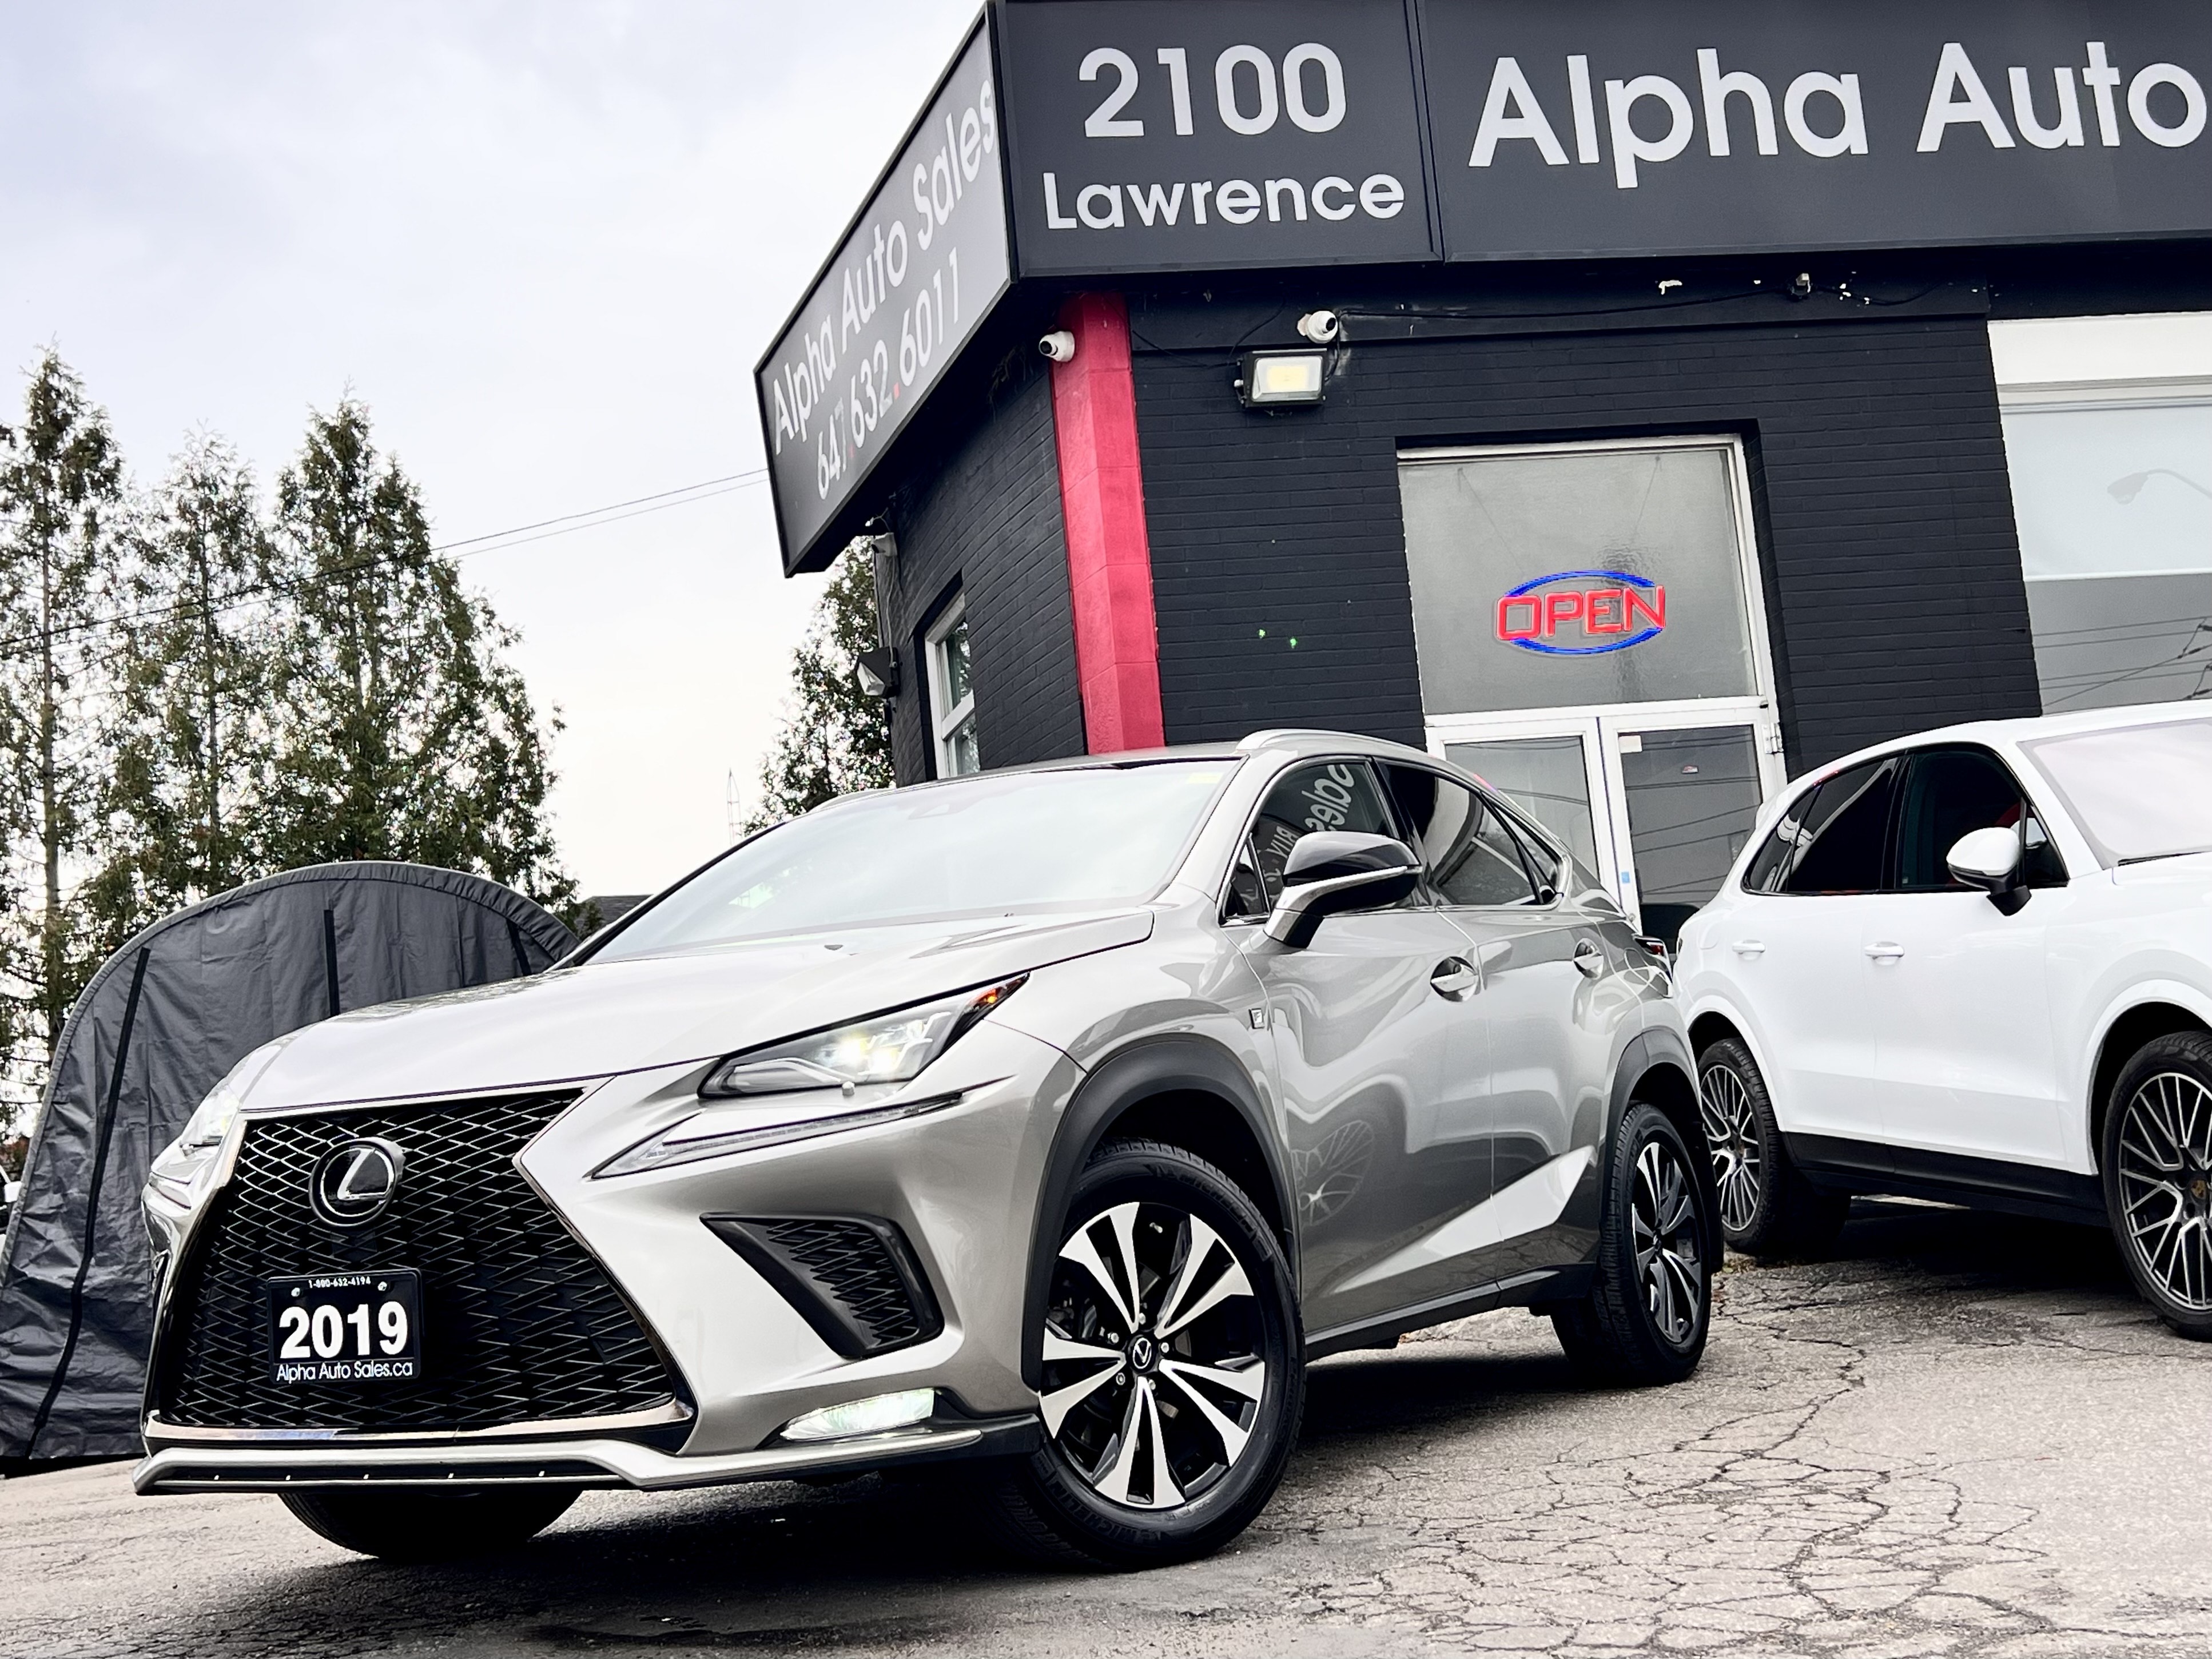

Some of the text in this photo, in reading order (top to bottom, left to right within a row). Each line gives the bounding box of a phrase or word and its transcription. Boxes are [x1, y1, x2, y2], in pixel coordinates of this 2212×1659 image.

[1079, 43, 1346, 137] 2100
[1469, 42, 2207, 189] Alpha Auto
[1043, 173, 1405, 229] Lawrence
[773, 79, 995, 455] Alpha Auto Sales
[1496, 585, 1666, 640] OPEN
[279, 1301, 408, 1359] 2019
[276, 1359, 413, 1385] Alpha Auto Sales.ca
